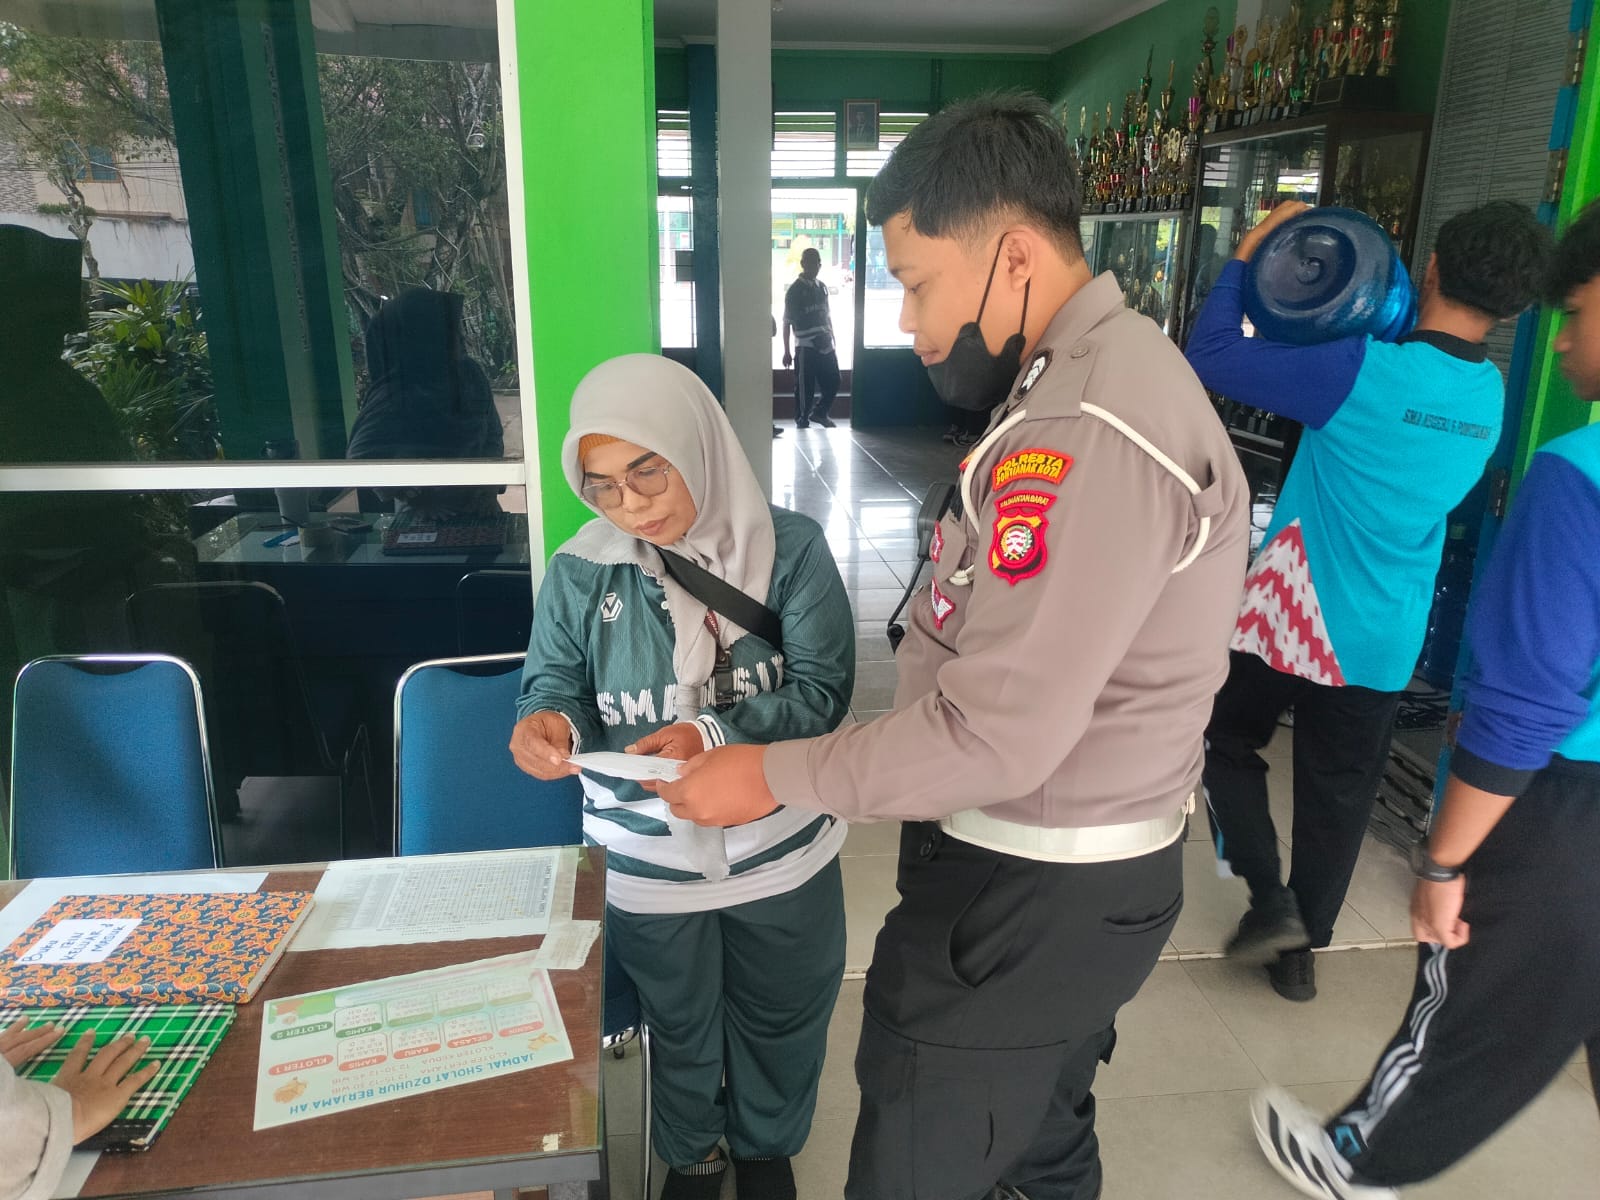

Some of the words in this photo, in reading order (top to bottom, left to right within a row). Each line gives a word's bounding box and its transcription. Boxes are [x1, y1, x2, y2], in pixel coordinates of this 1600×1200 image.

[996, 452, 1063, 476] POLRESTA
[995, 463, 1037, 486] PONTIANAK
[1037, 463, 1061, 478] KOTA
[275, 1030, 284, 1038] 2
[285, 1021, 328, 1036] KLOTER
[343, 1025, 373, 1036] KAMIS
[284, 1056, 327, 1071] KLOTER
[347, 1057, 377, 1069] KAMIS
[486, 1052, 535, 1070] JADWAL
[434, 1063, 483, 1082] SHOLAT
[377, 1075, 431, 1095] DZUHUR
